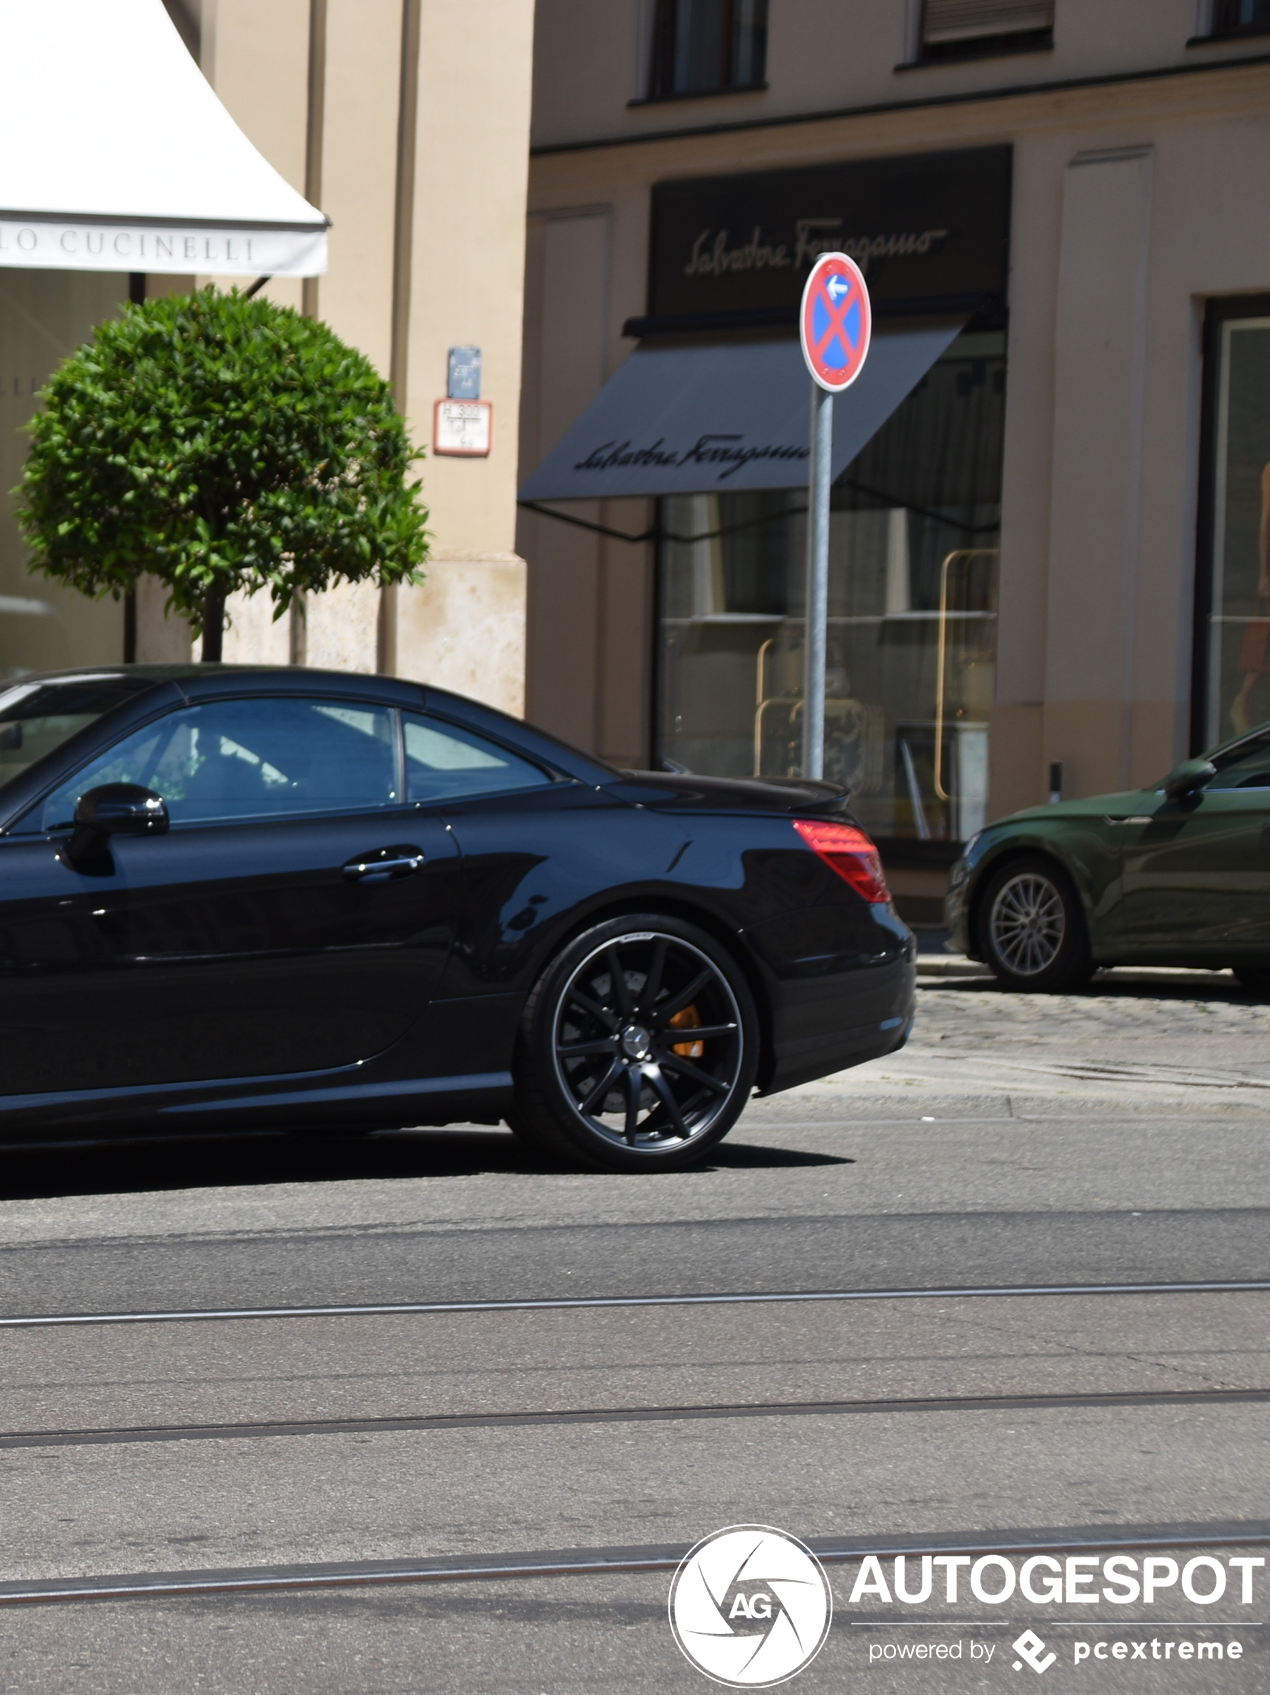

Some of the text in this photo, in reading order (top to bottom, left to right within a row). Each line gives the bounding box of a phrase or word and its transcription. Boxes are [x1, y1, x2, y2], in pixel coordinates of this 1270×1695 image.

[59, 230, 255, 262] CUCINELLI
[684, 225, 792, 275] Salvatore
[458, 404, 480, 417] 300
[574, 433, 811, 480] Salvatore Ferragamo
